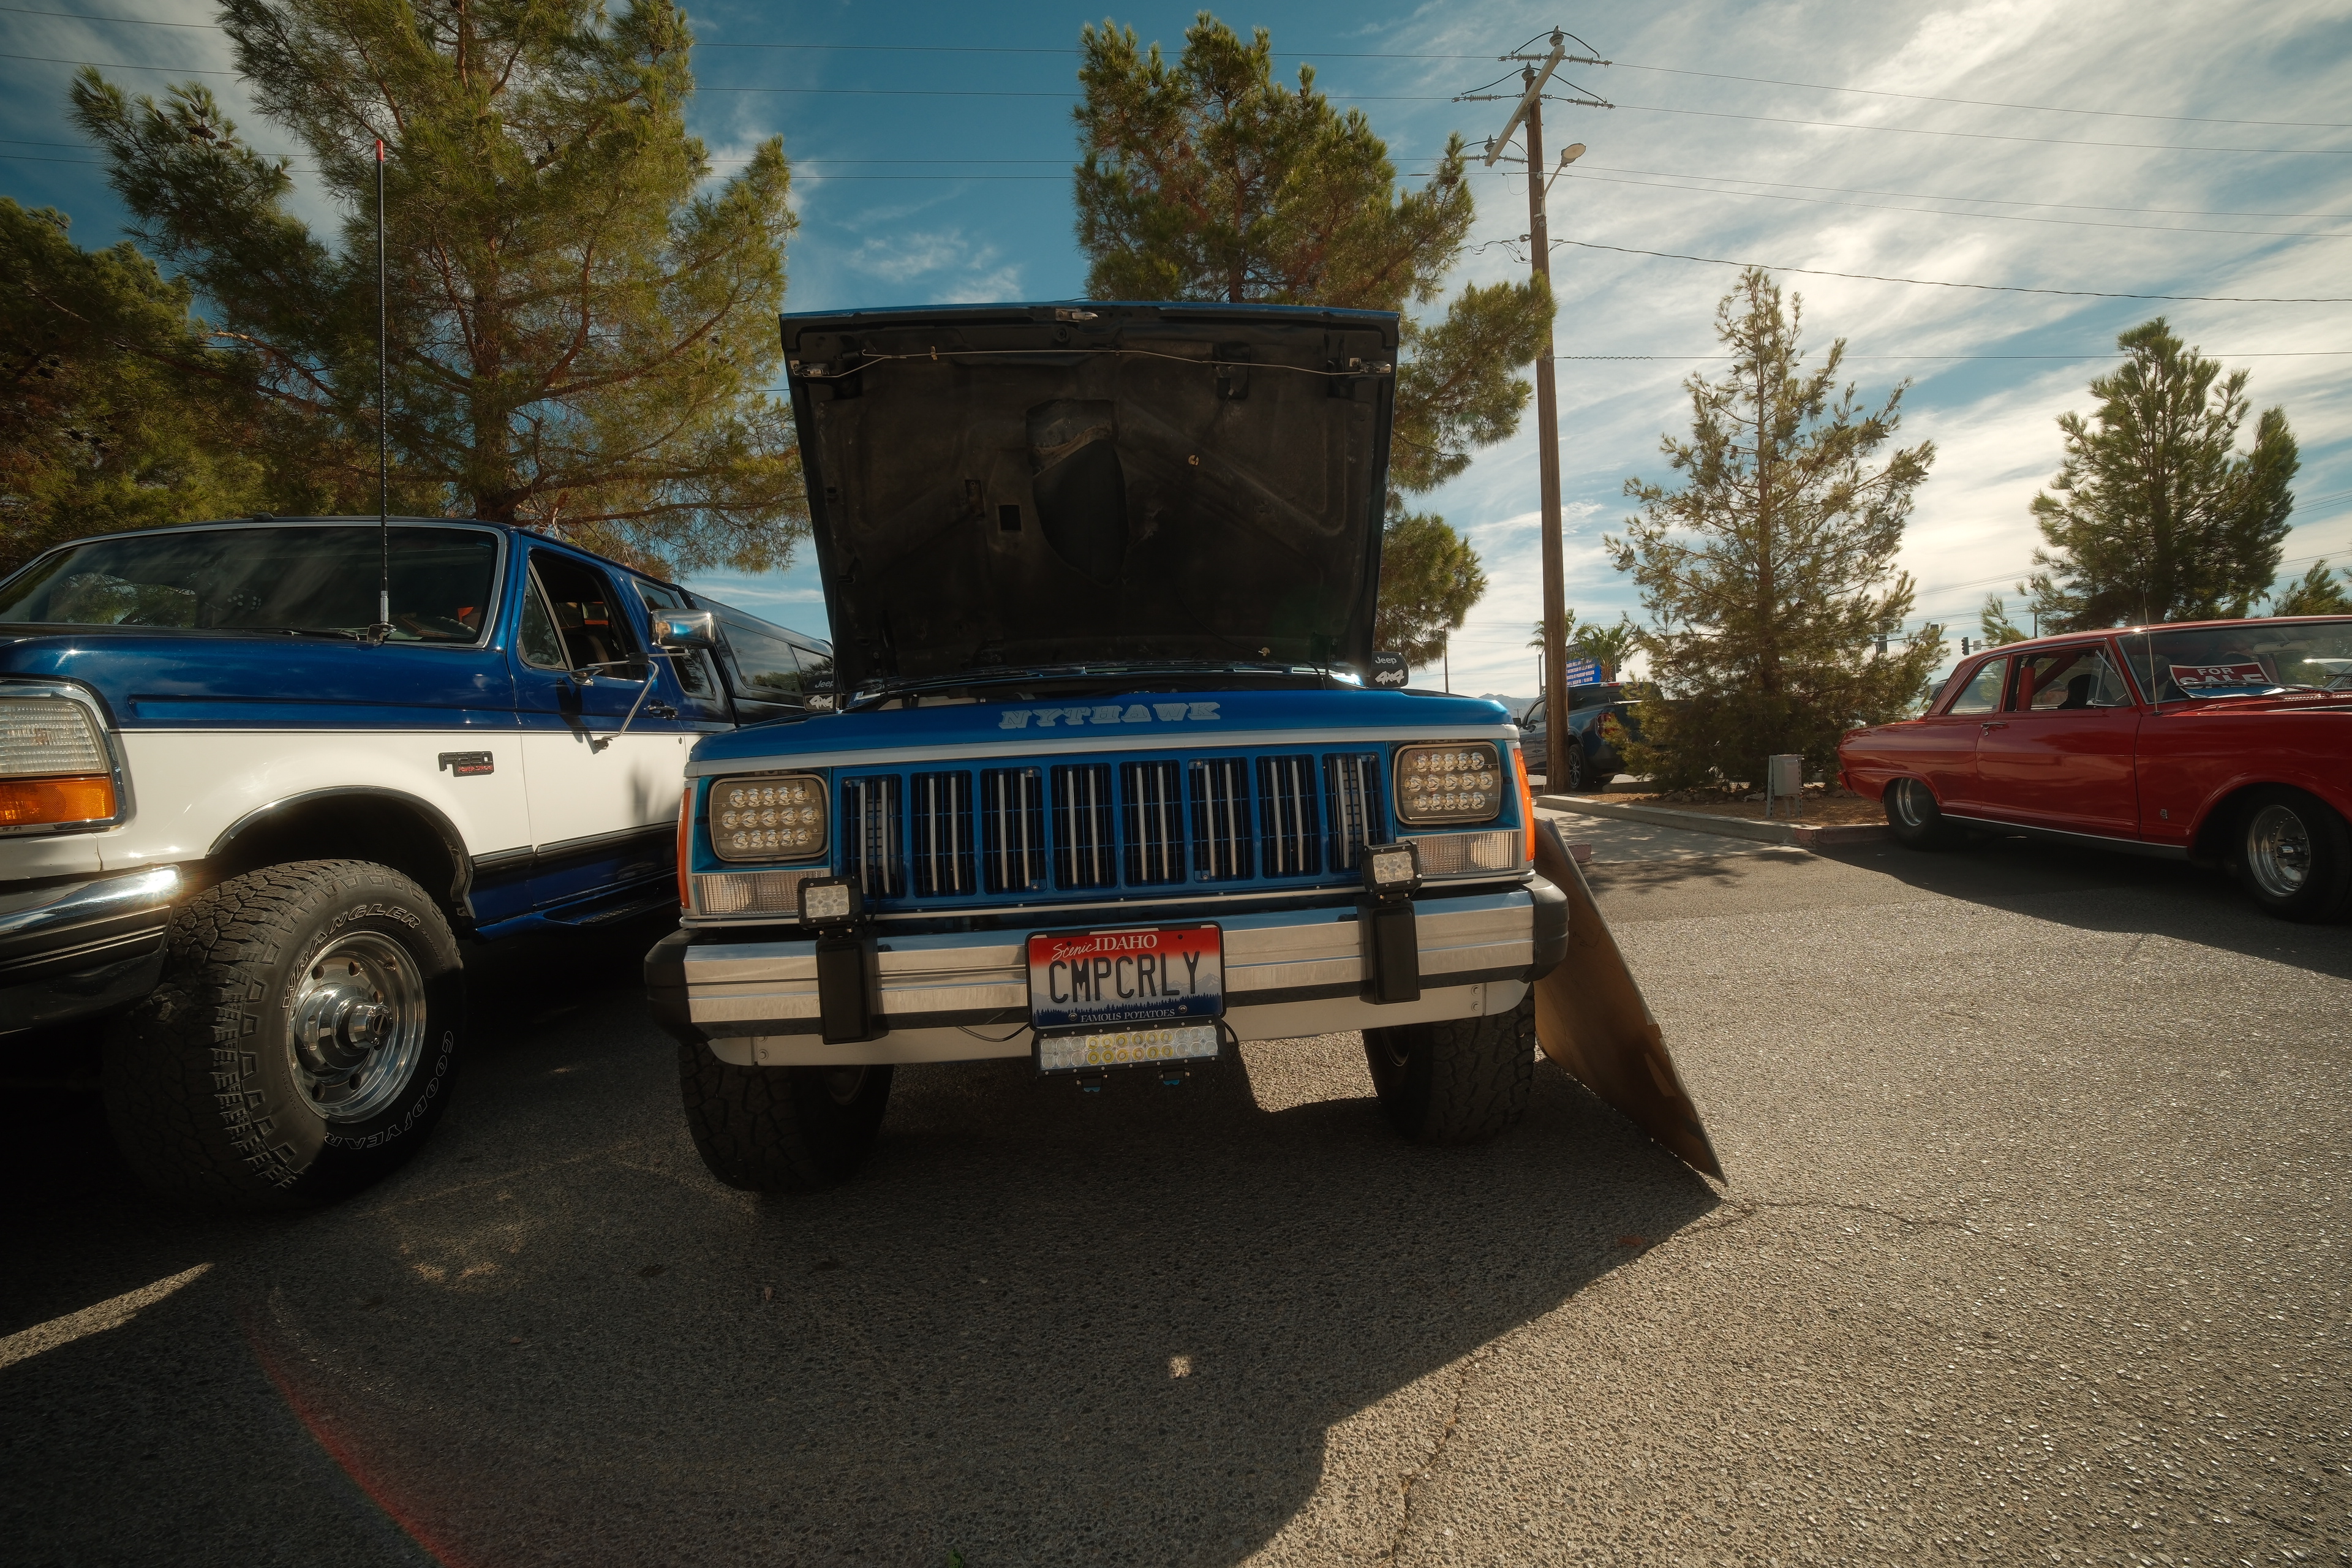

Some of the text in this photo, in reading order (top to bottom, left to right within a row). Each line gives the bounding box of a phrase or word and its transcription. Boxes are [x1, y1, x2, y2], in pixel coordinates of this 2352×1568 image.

[1375, 656, 1397, 665] Jeep
[2197, 667, 2234, 676] FOR
[2179, 674, 2265, 690] SALE
[998, 702, 1221, 729] NYTHAWK
[282, 903, 421, 1009] WRANGLER
[1051, 934, 1158, 960] Scenic IDAHO
[1049, 951, 1200, 1003] CMPCRLY
[1080, 1008, 1175, 1023] FAMOUS POTATOES
[323, 1030, 453, 1150] GOODYEAR
